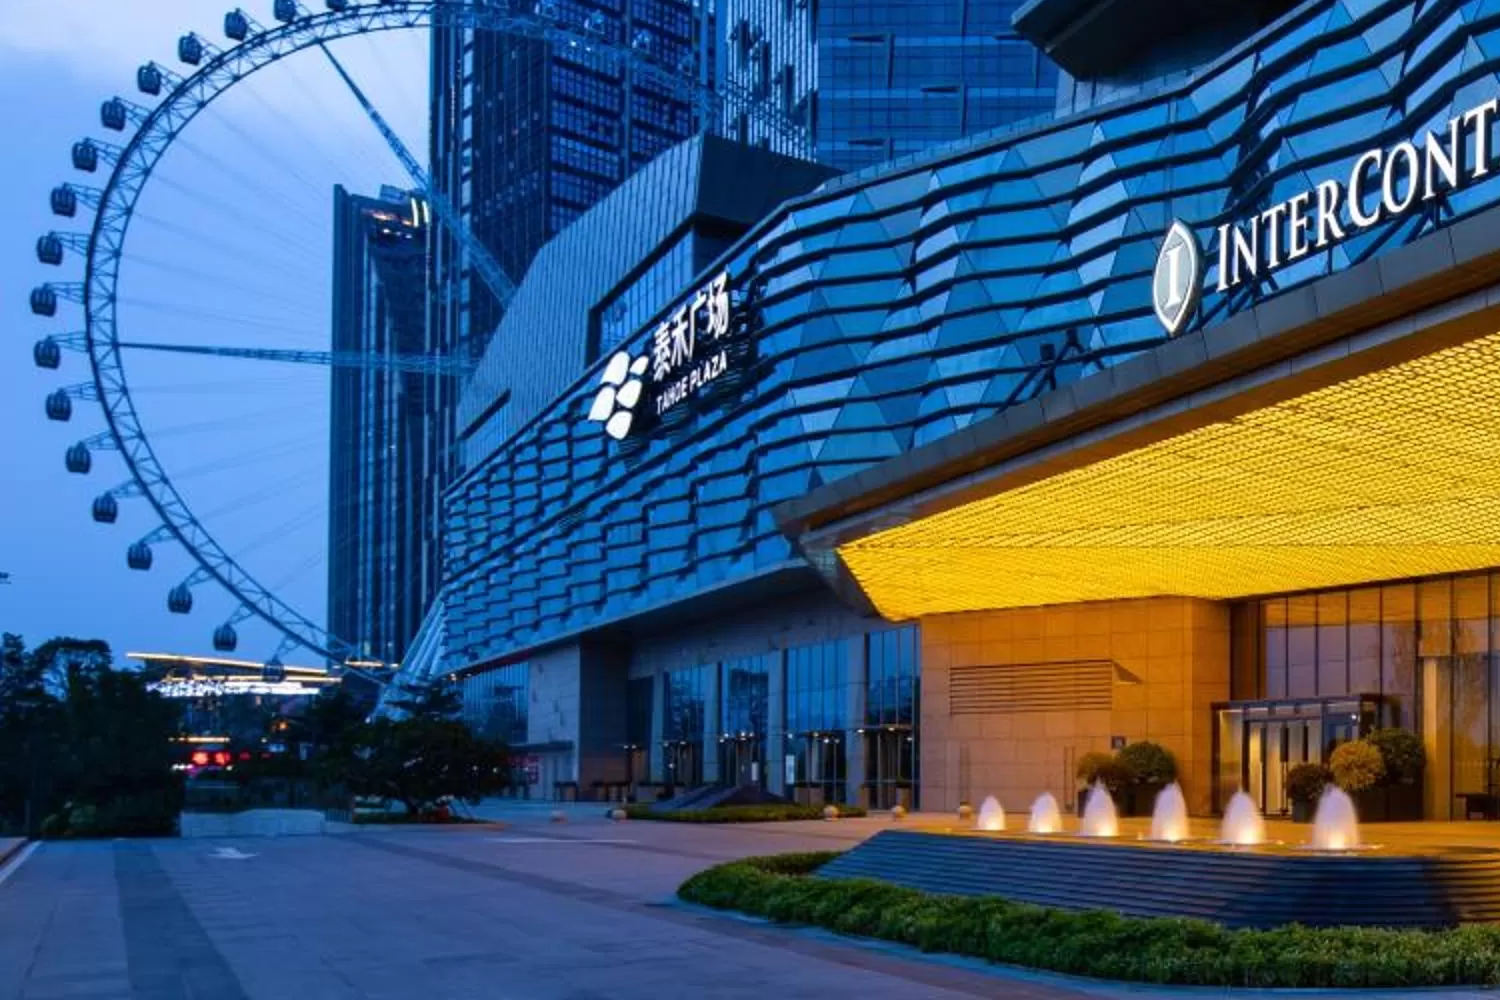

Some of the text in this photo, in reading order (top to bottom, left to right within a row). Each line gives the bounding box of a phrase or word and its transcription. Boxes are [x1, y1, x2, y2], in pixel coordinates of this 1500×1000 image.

[653, 271, 730, 382] 泰禾广场
[656, 350, 727, 416] TAHOE PLAZA
